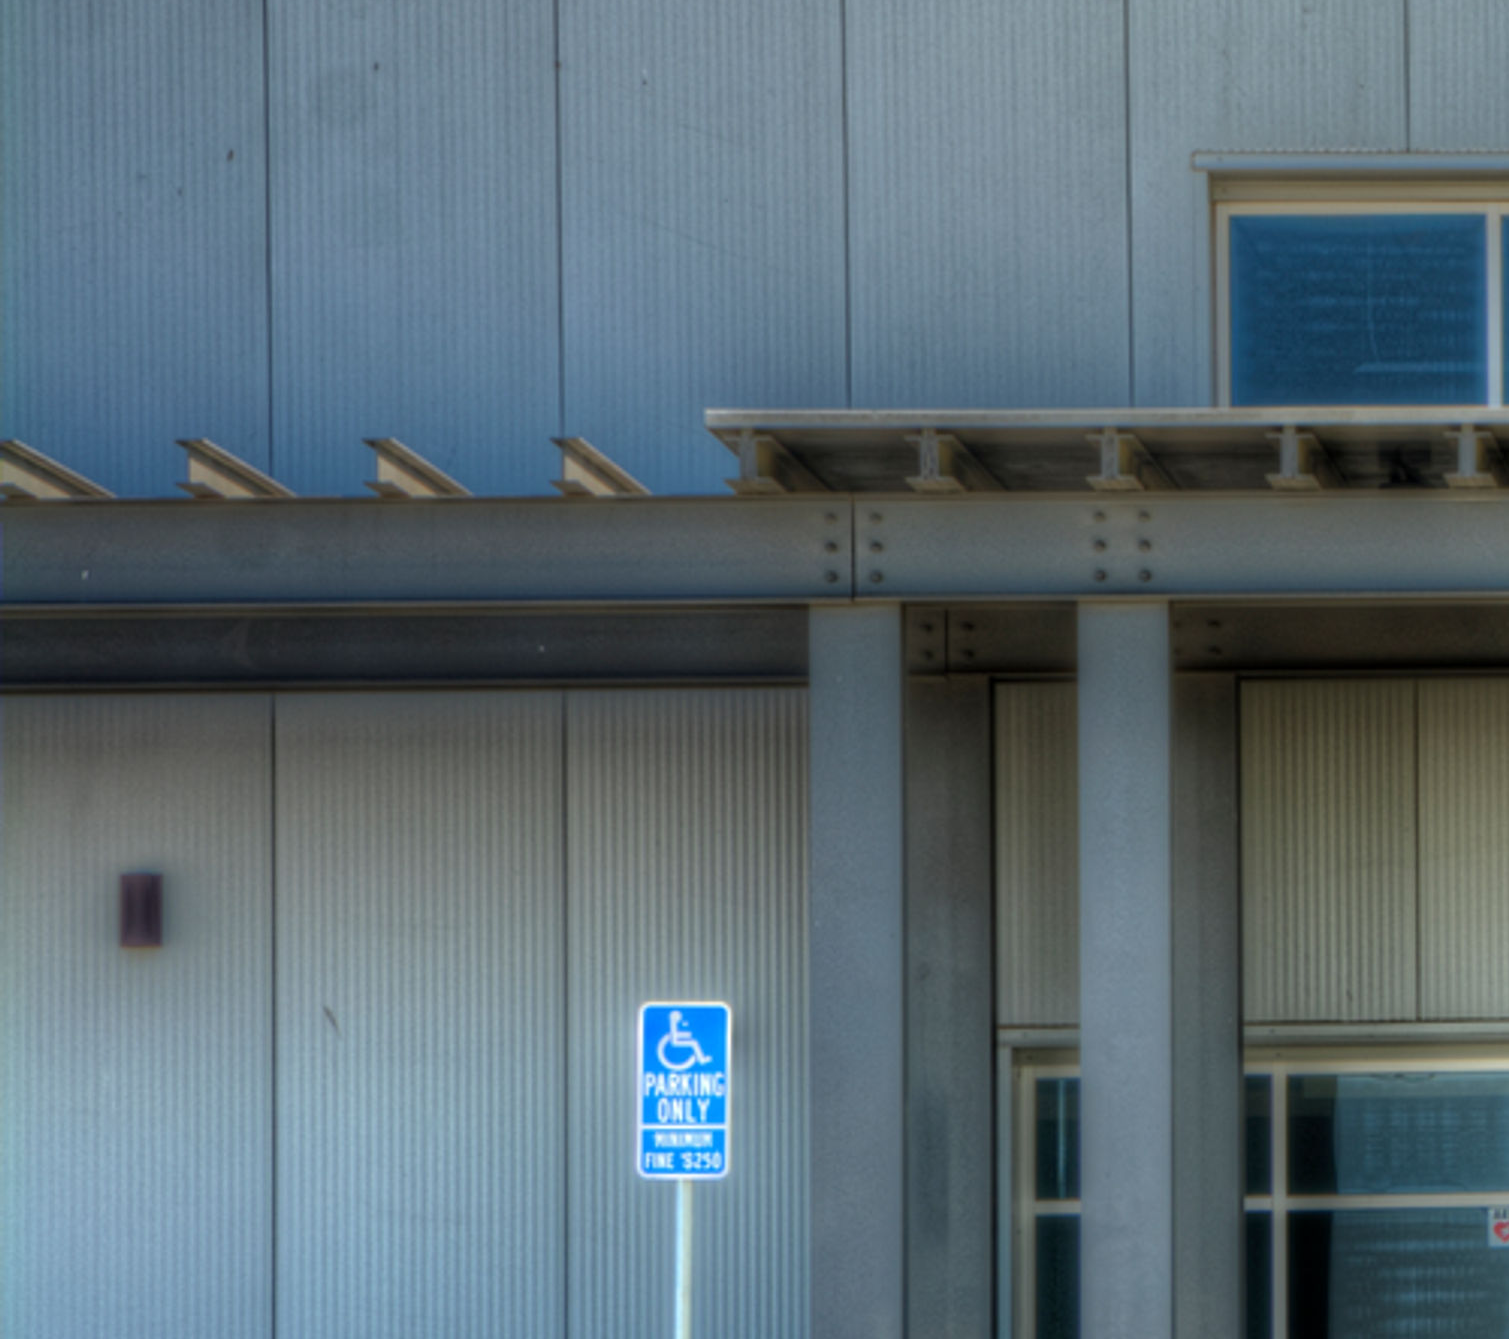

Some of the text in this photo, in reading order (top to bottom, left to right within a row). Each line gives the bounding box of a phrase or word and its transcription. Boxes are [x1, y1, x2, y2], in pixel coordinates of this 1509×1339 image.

[645, 1072, 725, 1097] PARKING
[657, 1098, 710, 1123] ONLY
[654, 1132, 713, 1148] MINIMUM
[645, 1151, 674, 1169] FINE
